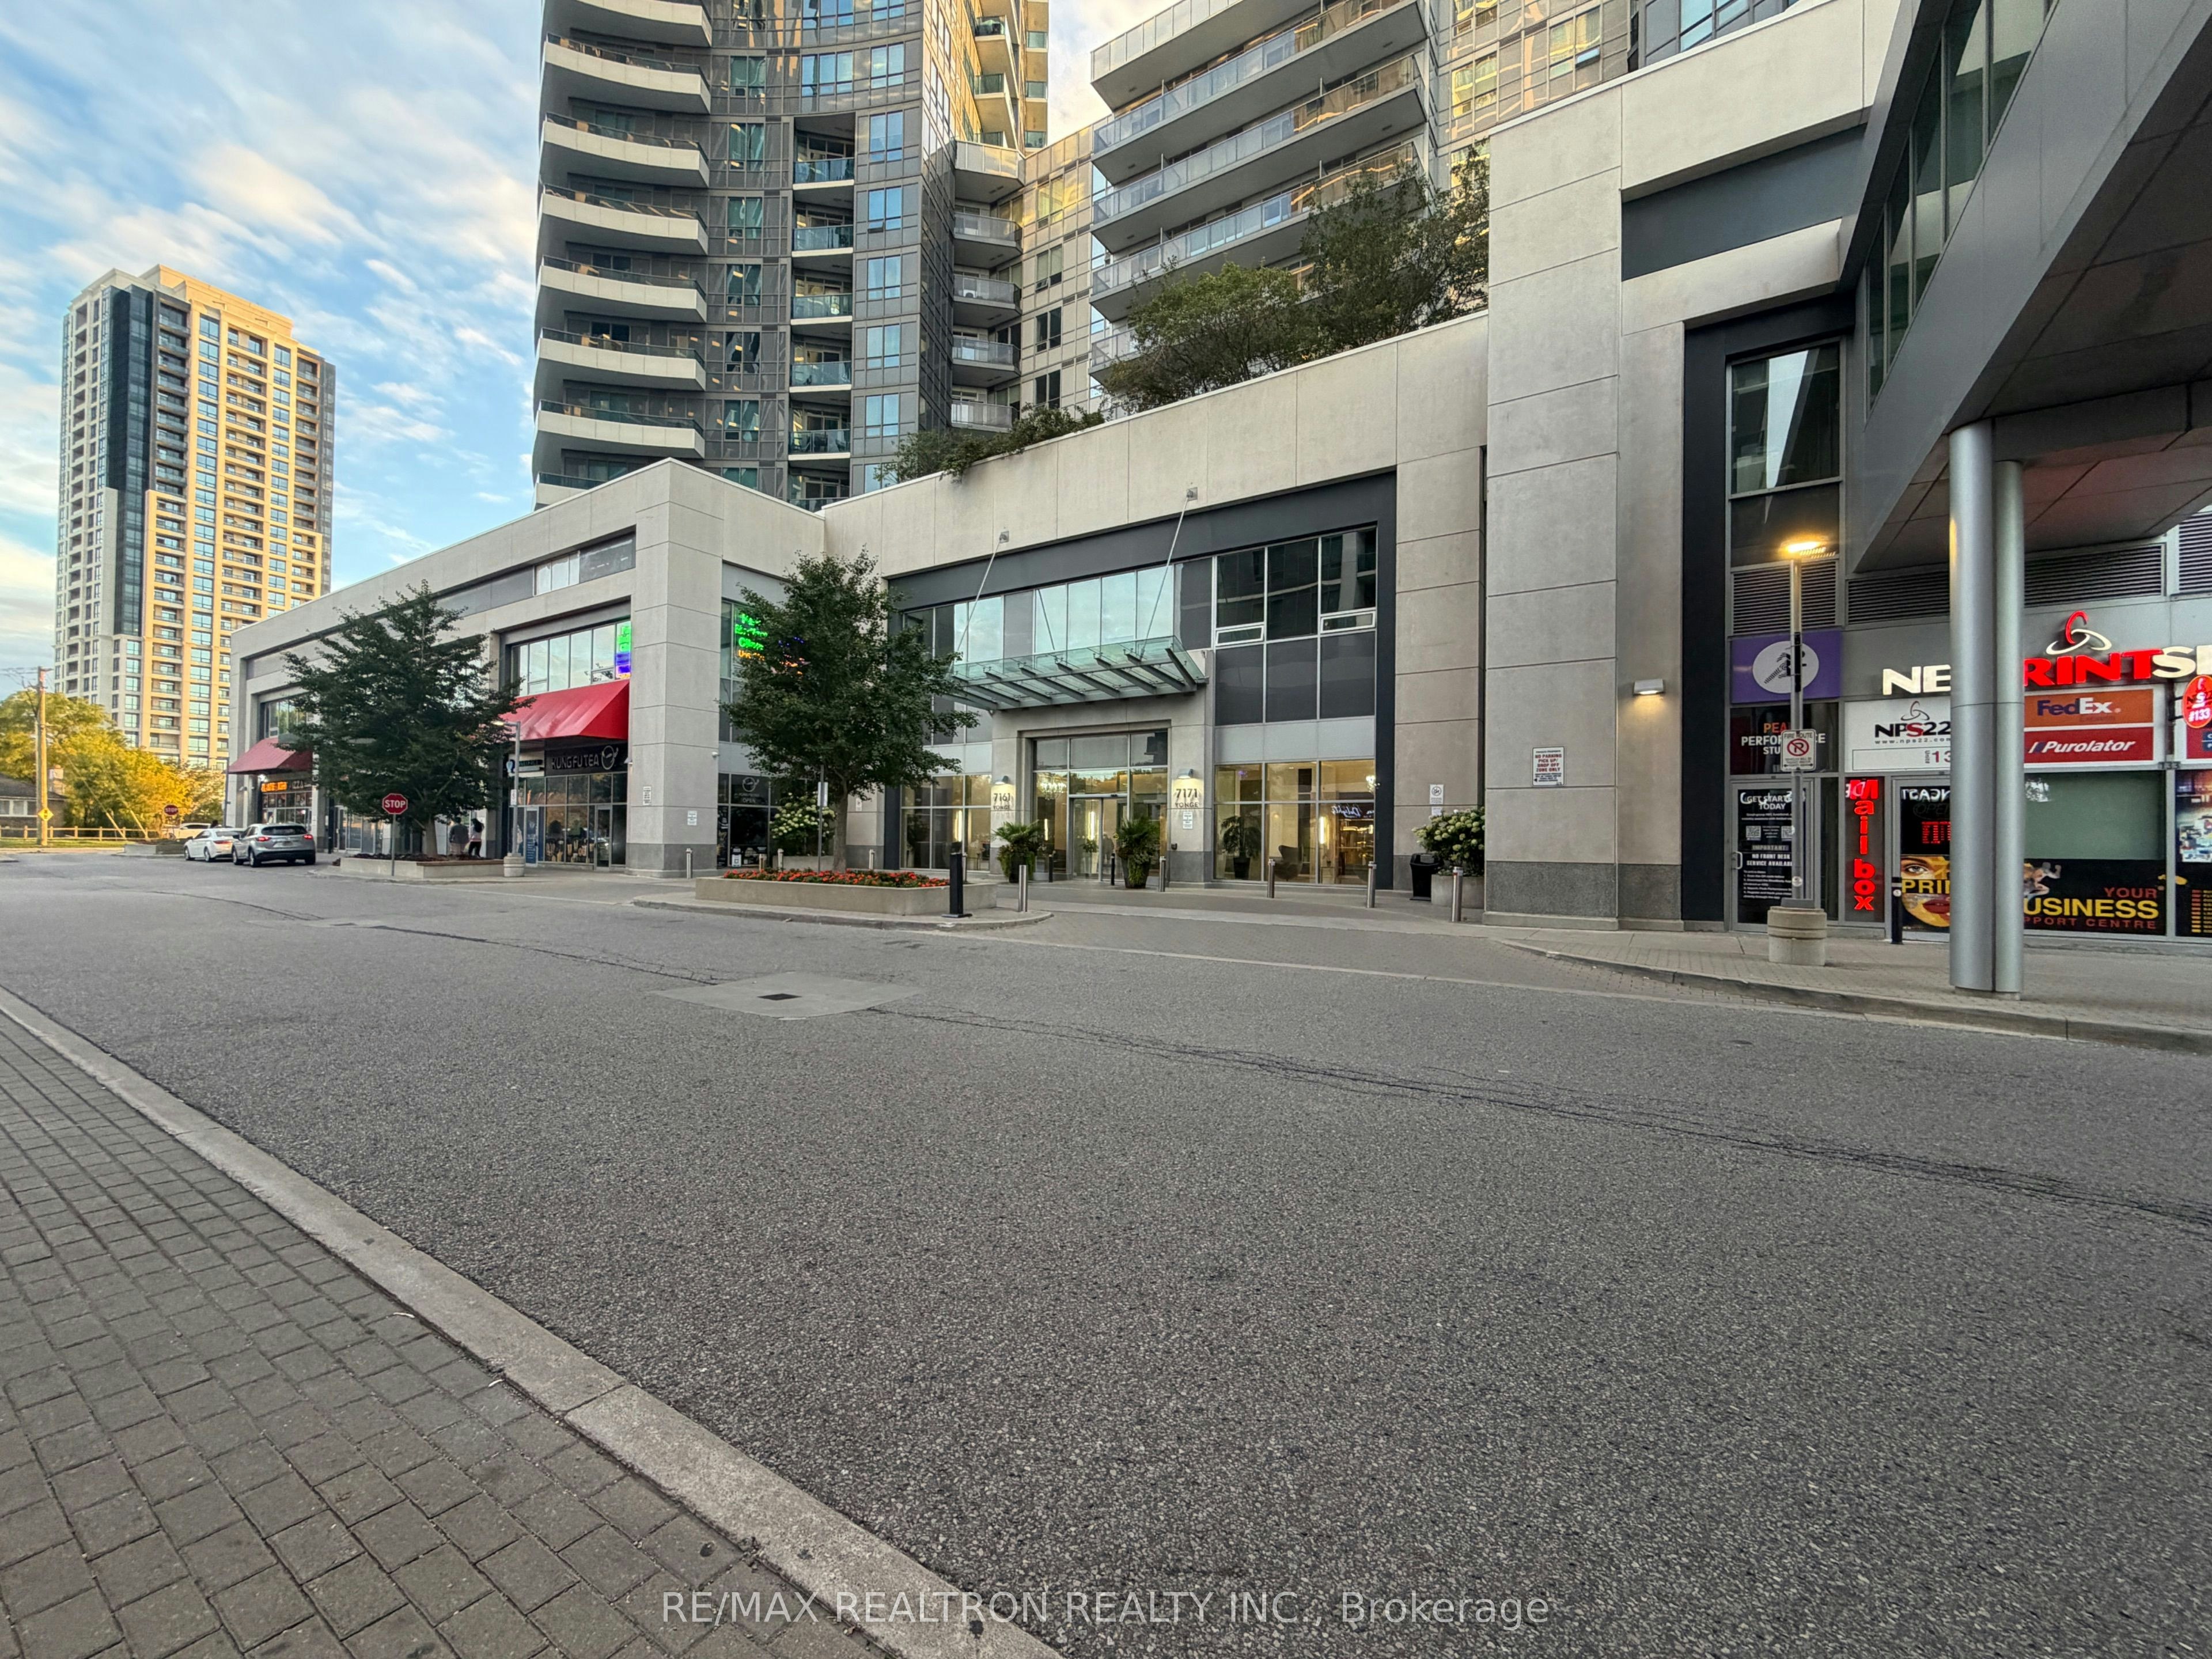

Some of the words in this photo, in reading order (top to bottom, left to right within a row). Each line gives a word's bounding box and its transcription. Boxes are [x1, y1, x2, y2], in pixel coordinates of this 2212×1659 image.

[1883, 664, 1951, 695] NE
[2037, 697, 2112, 716] FedEx
[1764, 722, 1788, 733] PEA
[1875, 721, 1951, 737] NPS22
[1763, 746, 1781, 755] STU
[2043, 740, 2136, 753] Purolator
[1932, 751, 1951, 763] 13
[993, 793, 1010, 801] 7161
[1176, 788, 1198, 798] 7171
[384, 800, 406, 808] STOP
[2104, 887, 2157, 899] YOUR
[2024, 897, 2159, 919] USINESS
[2024, 917, 2077, 926] PPORT
[2086, 918, 2157, 929] CENTRE
